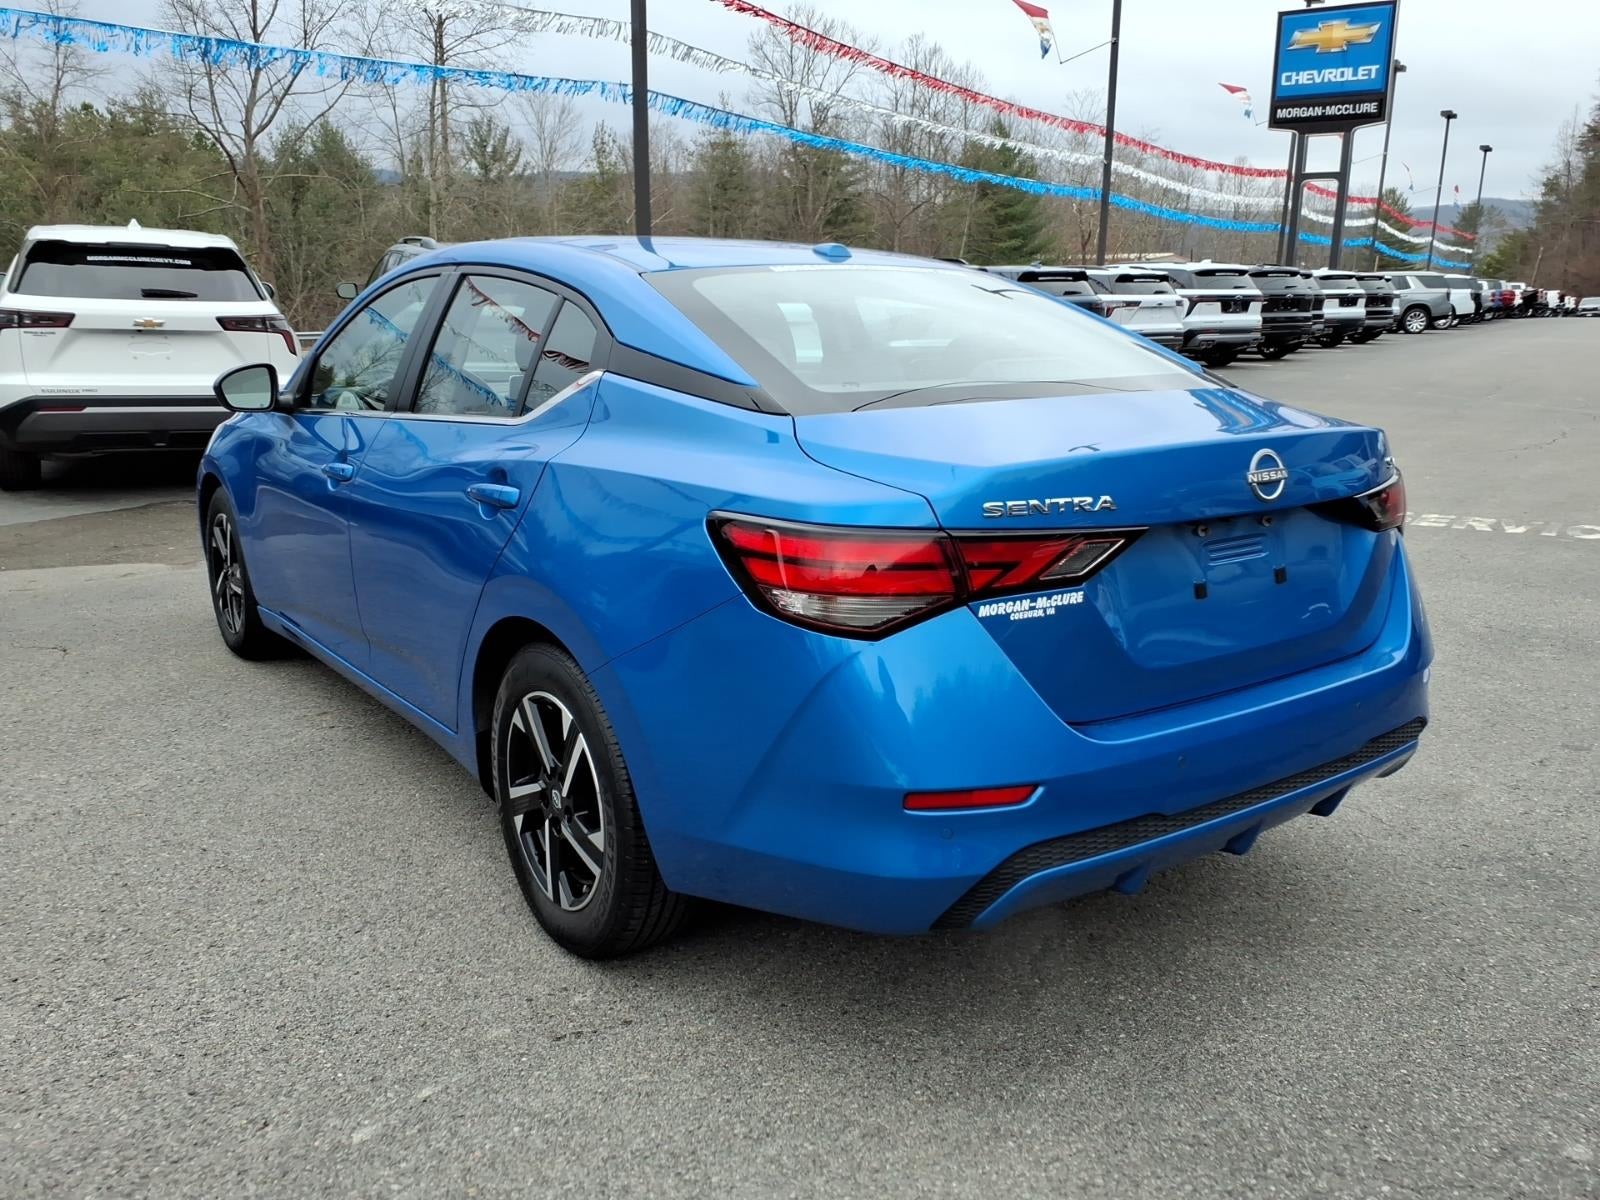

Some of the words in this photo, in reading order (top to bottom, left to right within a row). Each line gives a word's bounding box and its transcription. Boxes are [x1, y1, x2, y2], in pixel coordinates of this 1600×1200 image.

[1281, 65, 1380, 86] CHEVROLET
[1276, 102, 1379, 119] MORGAN-MCCLURE
[1248, 469, 1288, 483] NISSAN
[982, 495, 1118, 517] SENTRA
[978, 591, 1085, 618] MORGAN-McCLURE
[1046, 607, 1056, 615] VA
